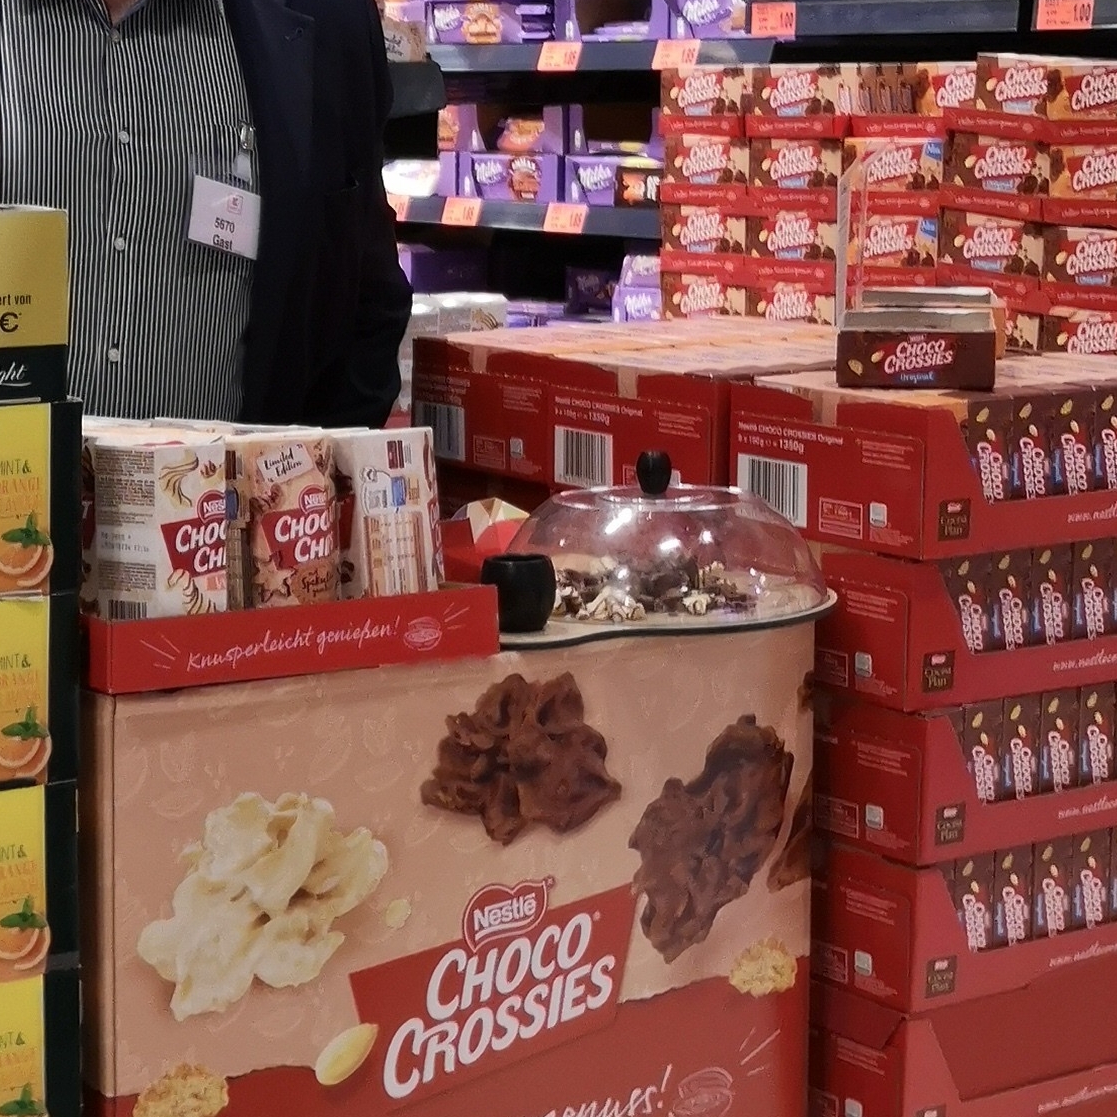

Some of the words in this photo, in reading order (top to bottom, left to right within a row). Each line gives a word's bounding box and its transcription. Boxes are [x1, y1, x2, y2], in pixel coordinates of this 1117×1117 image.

[212, 234, 233, 251] Gast
[214, 217, 235, 233] 5670
[14, 293, 31, 307] von
[884, 348, 954, 374] CROSSIES
[895, 337, 946, 361] CHOCO
[990, 451, 1004, 500] CHOCO
[1032, 447, 1046, 495] CHOCO
[1073, 443, 1087, 491] CHOCO
[186, 632, 314, 672] Knusperleicht
[317, 615, 401, 650] genießen!
[473, 893, 536, 931] Nestlé
[426, 912, 593, 1021] CHOCO
[383, 954, 616, 1099] CROSSIES
